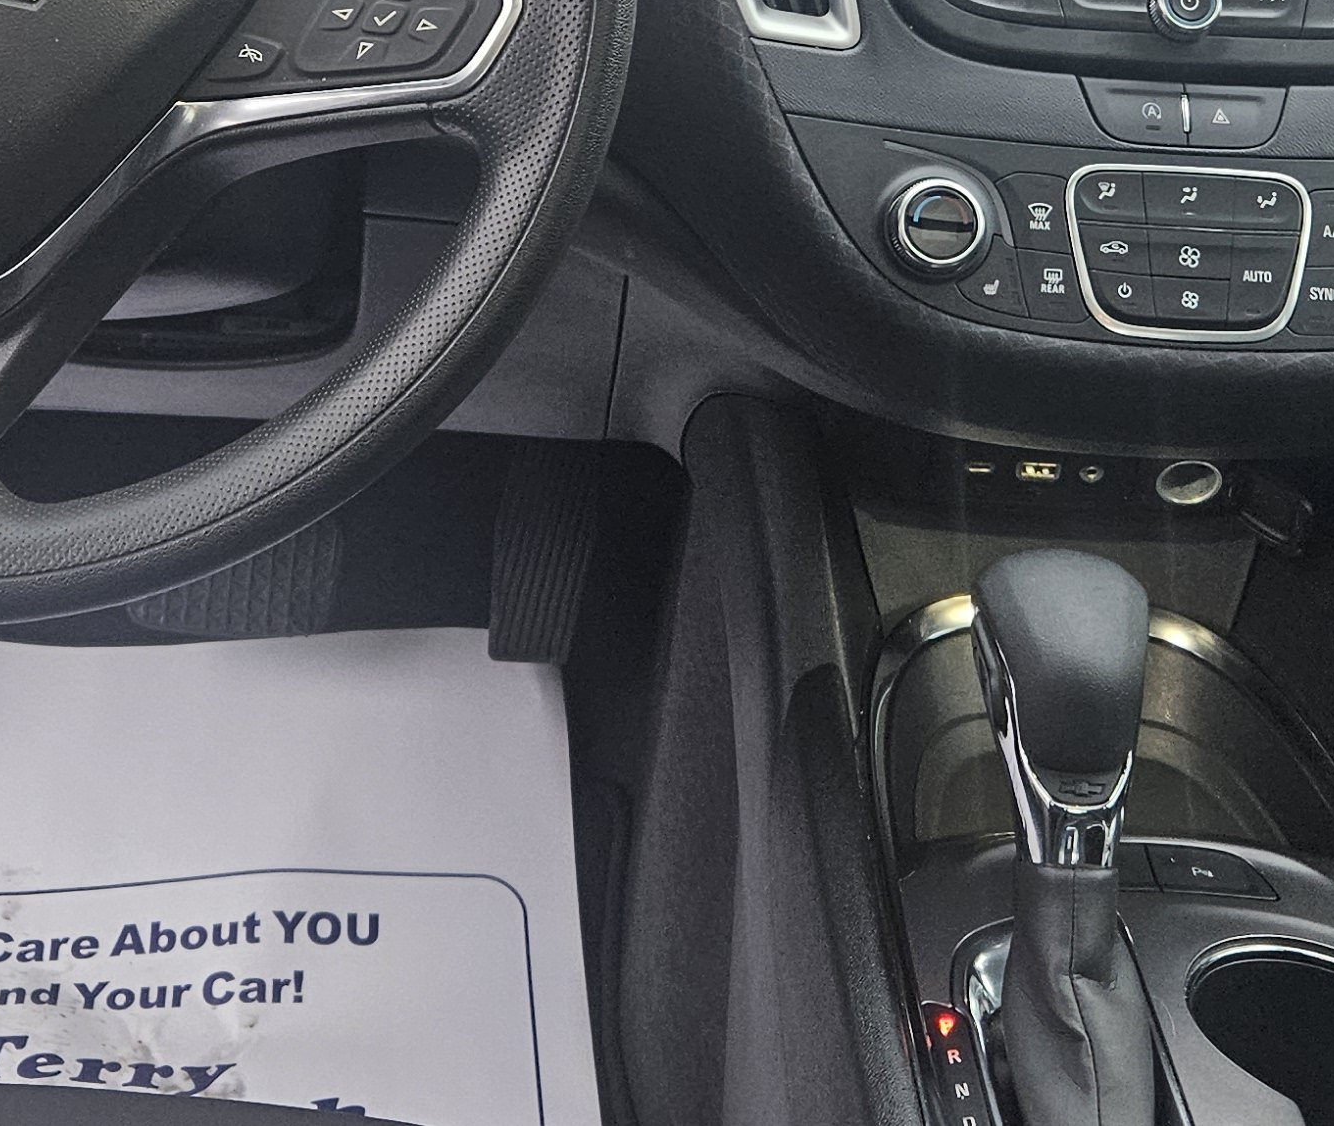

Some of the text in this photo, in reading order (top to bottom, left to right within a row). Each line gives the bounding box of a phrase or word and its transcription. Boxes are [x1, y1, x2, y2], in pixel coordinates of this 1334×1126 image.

[1029, 220, 1051, 231] MAX
[1242, 269, 1272, 283] AUTO
[1040, 282, 1065, 294] REAR
[109, 911, 261, 957] About
[272, 910, 380, 946] YOU
[73, 981, 193, 1010] Your
[202, 970, 305, 1006] Car!
[938, 1016, 955, 1037] P
[947, 1049, 962, 1064] R
[954, 1082, 970, 1098] N
